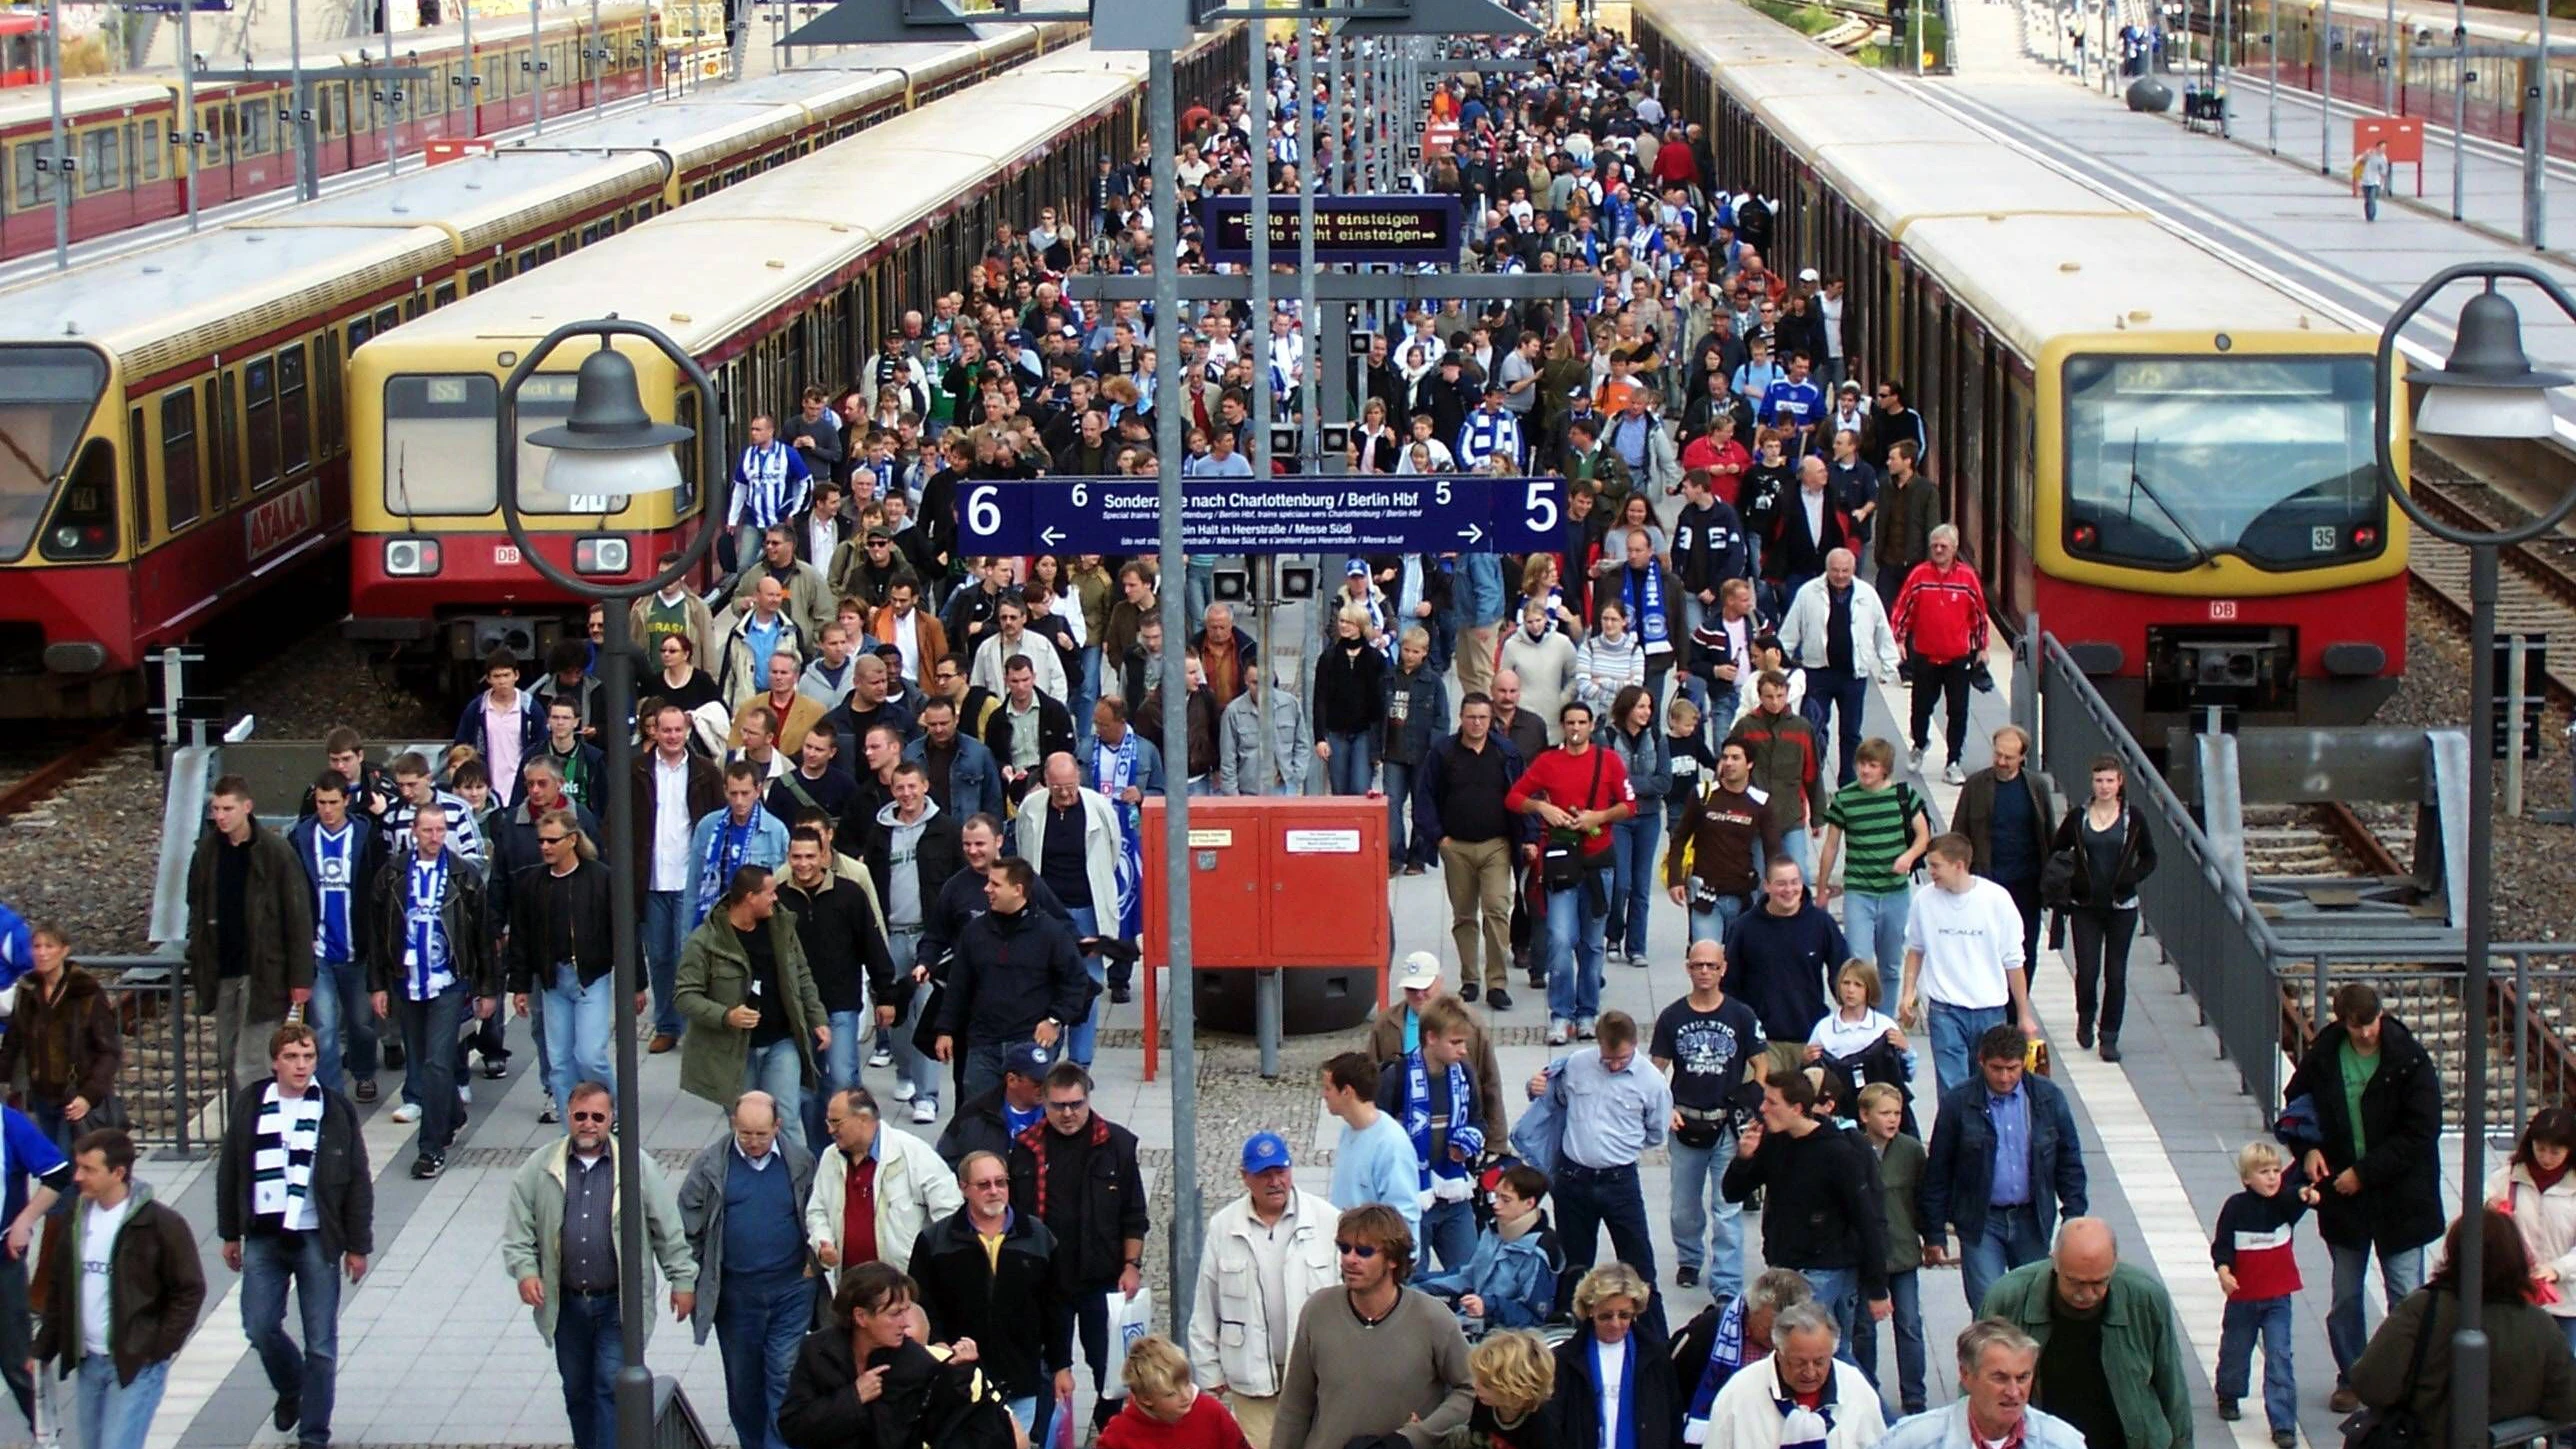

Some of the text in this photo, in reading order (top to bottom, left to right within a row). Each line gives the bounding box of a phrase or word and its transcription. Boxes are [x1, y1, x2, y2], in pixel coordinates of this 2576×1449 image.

[1244, 213, 1420, 228] Bte nht einsteigen
[1245, 229, 1422, 243] Bte nht einsteigen
[1071, 483, 1089, 507] 6
[1435, 481, 1452, 505] 5
[1104, 493, 1188, 508] Sonderze
[1191, 493, 1226, 508] nach
[1229, 492, 1335, 511] Charlottenburg
[1347, 492, 1390, 508] Berlin
[1392, 492, 1419, 508] Hbf
[1525, 482, 1559, 532] 5
[968, 484, 1002, 536] 6
[1328, 510, 1381, 520] Charlottenburg
[1198, 523, 1220, 535] Halt
[1221, 523, 1231, 535] in
[1232, 523, 1287, 535] Heerstraße
[1295, 523, 1328, 535] Messe
[2314, 529, 2335, 547] 35
[497, 548, 518, 562] DB
[2212, 603, 2235, 617] DB
